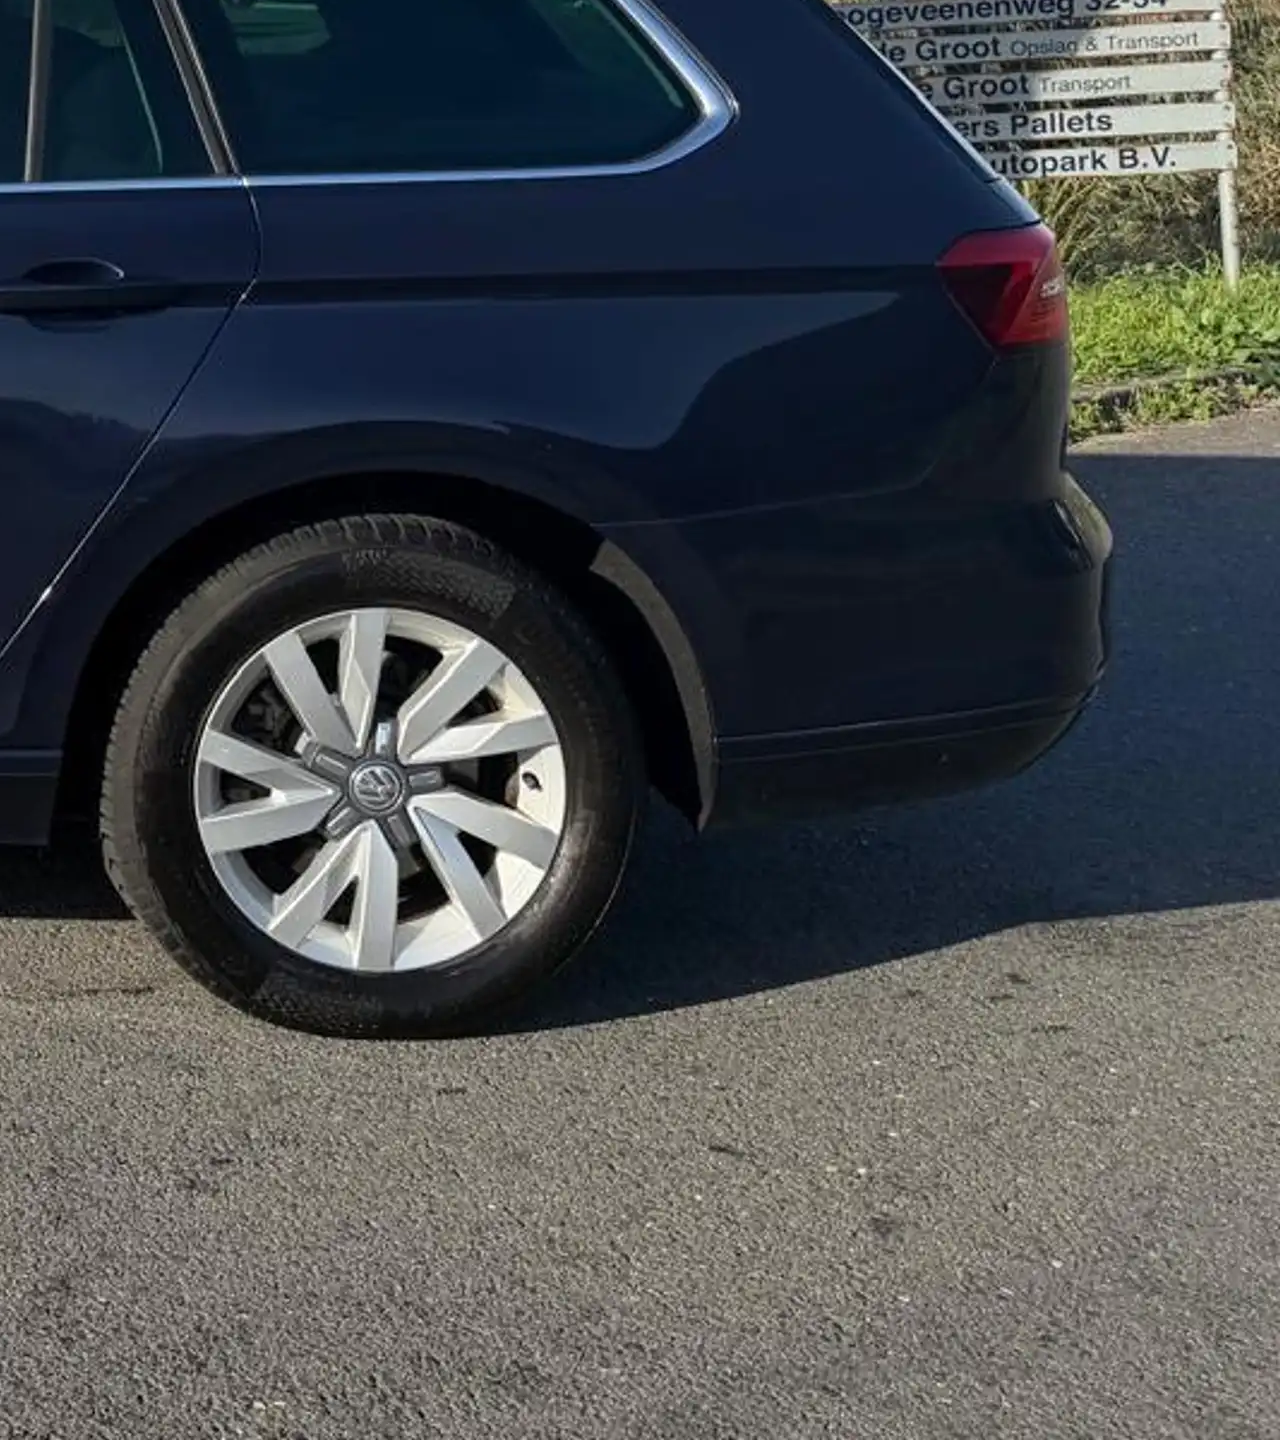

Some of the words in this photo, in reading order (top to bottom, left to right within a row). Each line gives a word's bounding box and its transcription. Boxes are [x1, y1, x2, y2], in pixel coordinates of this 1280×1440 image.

[916, 36, 1002, 61] Groot
[1010, 38, 1078, 58] Opslag
[1085, 35, 1098, 51] &
[1106, 32, 1198, 51] Transport
[944, 74, 1030, 99] Groot
[1041, 75, 1131, 94] Transport
[1011, 111, 1113, 136] Pallets
[1119, 147, 1176, 170] B.V.
